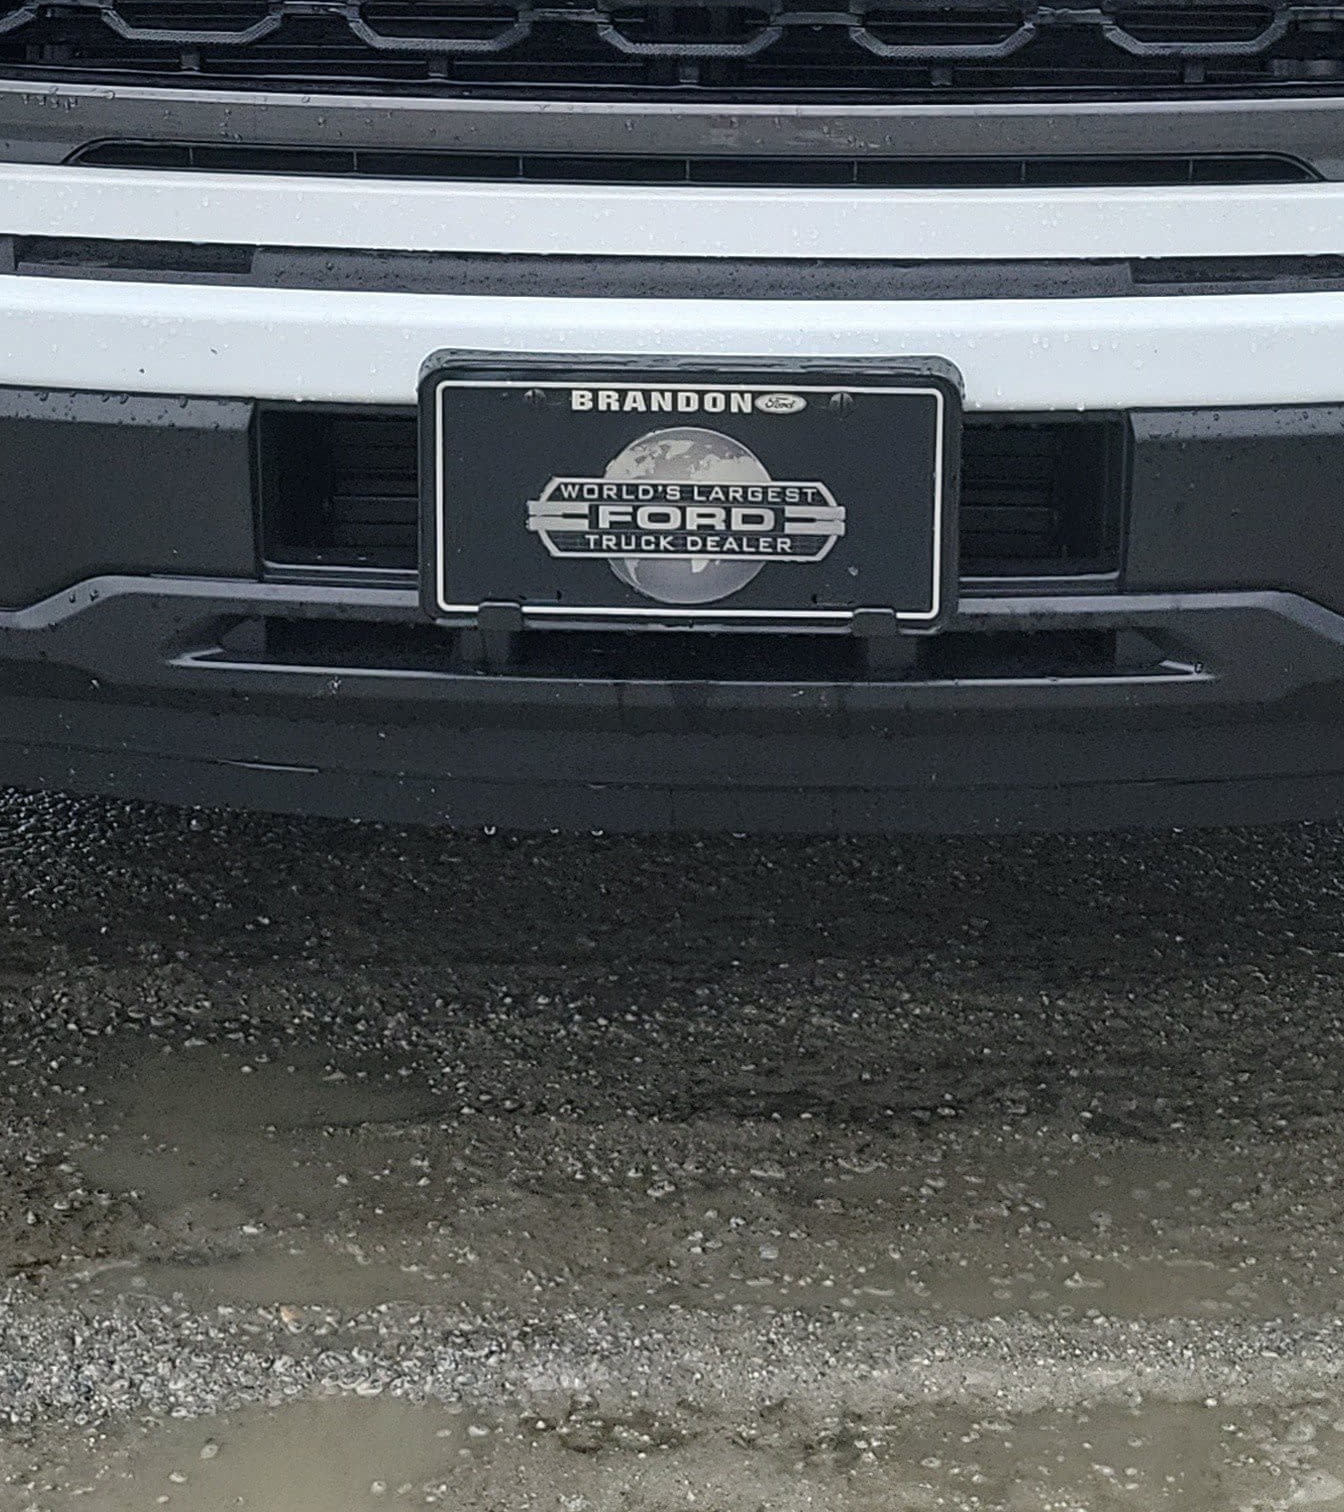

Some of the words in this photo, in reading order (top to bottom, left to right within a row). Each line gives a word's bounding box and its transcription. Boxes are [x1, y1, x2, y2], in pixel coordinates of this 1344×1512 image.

[570, 390, 752, 414] BRANDON
[560, 484, 681, 501] WORLD'S
[694, 486, 817, 503] LARGEST
[598, 505, 774, 531] FORD
[586, 534, 675, 550] TRUCK
[689, 536, 793, 553] DEALER
